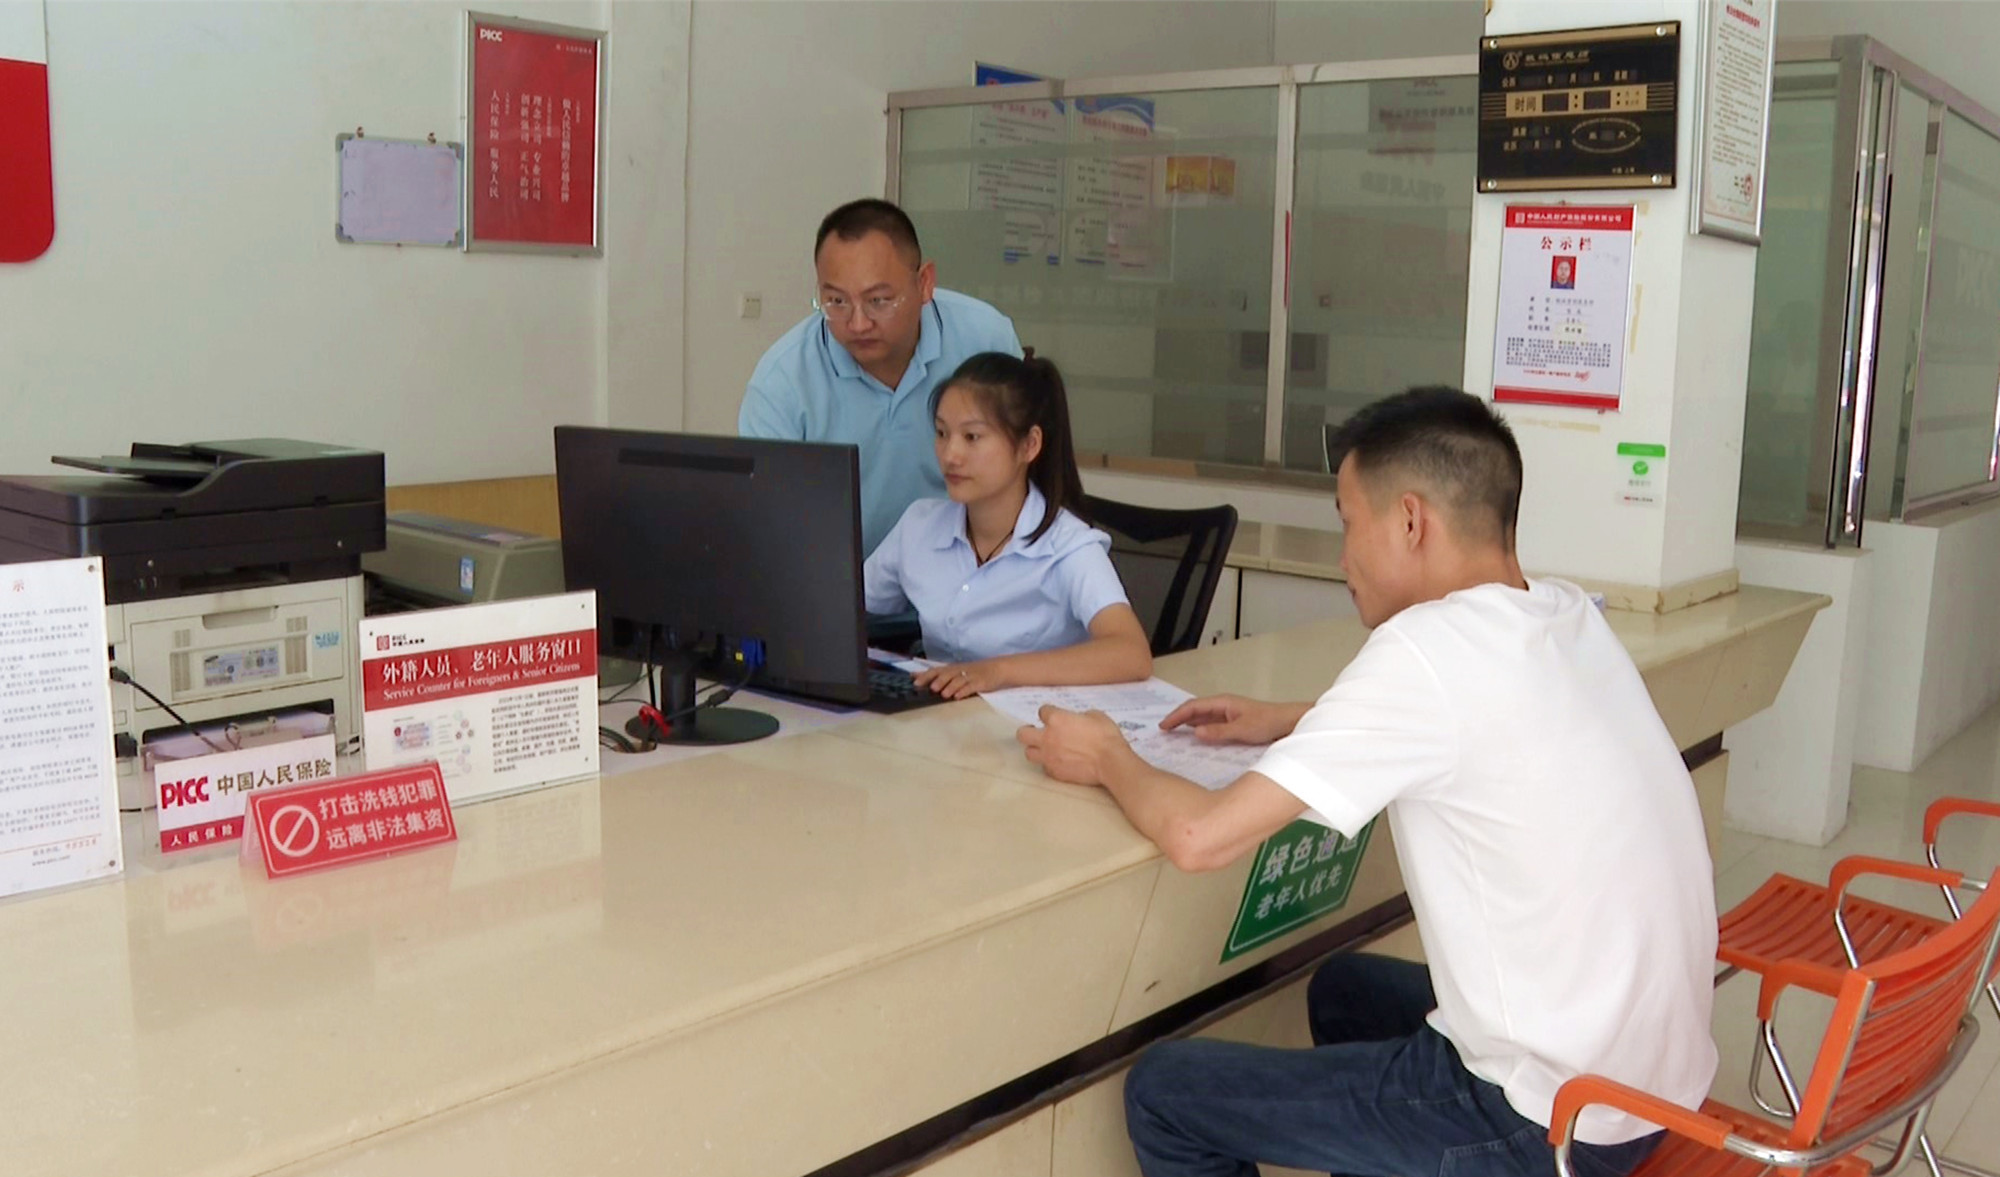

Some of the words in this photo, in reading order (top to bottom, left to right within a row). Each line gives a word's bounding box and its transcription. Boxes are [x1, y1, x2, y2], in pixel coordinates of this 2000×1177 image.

[480, 29, 503, 42] PICC
[490, 90, 500, 140] 人民保险
[1514, 97, 1537, 112] 时间
[489, 147, 499, 198] 服务人民
[1541, 236, 1592, 251] 公示栏
[383, 638, 581, 685] 外籍人员、老年人服务窗口
[384, 686, 415, 701] Service
[417, 681, 451, 696] Counter
[453, 677, 467, 689] for
[468, 672, 511, 688] Foreigners
[512, 670, 519, 680] &
[522, 666, 547, 679] Senior
[549, 661, 580, 675] Citizens
[160, 777, 209, 809] PICC
[217, 758, 332, 796] 中国人民保险
[317, 779, 438, 820] 打击洗钱犯罪
[170, 824, 233, 846] 人民保险
[325, 807, 445, 851] 远离非法集资
[1255, 865, 1342, 920] 老年人优先
